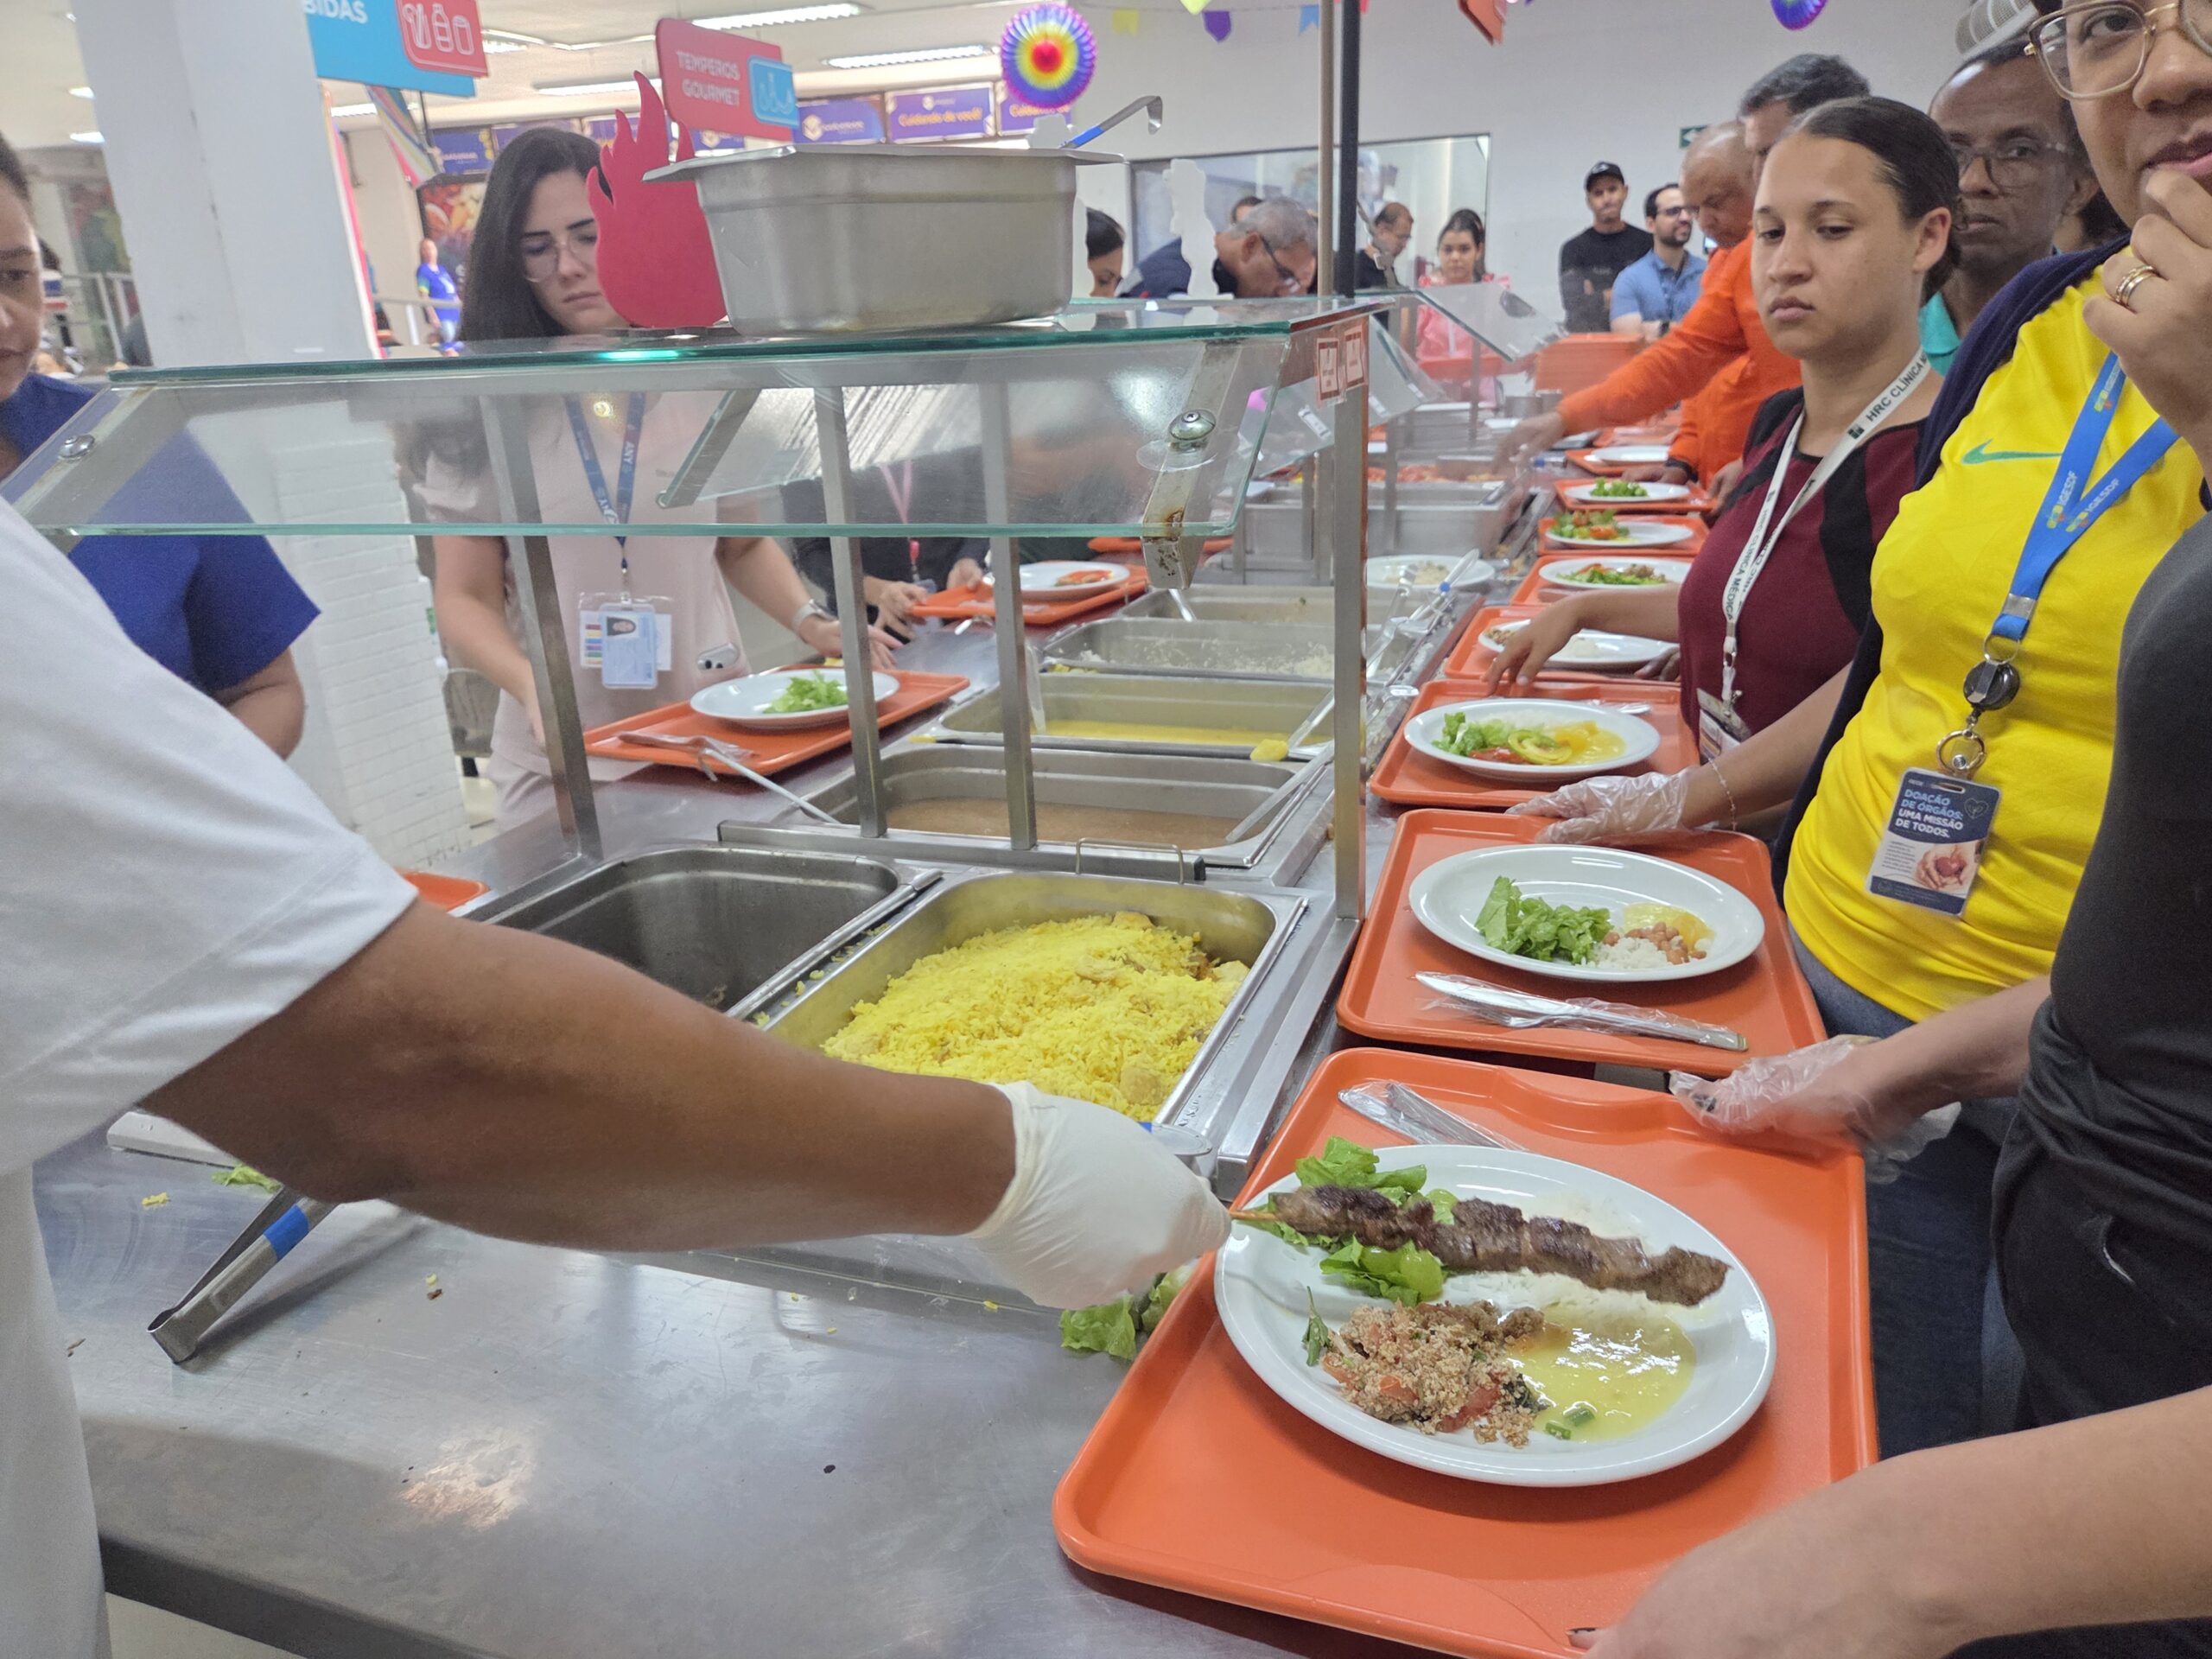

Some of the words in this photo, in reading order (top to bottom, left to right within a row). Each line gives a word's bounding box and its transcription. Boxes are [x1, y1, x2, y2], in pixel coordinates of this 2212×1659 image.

[676, 50, 741, 81] TEMPEROS
[682, 78, 741, 107] GOURMET
[1866, 397, 1891, 423] HRC
[1890, 361, 1923, 397] CLÍNICA
[2057, 469, 2077, 506] IGESDF
[2084, 477, 2120, 512] IGESDF
[1725, 577, 1743, 620] MÉDICA
[1901, 798, 1916, 809] DE
[1916, 802, 1964, 820] ÓRGÃOS:
[1904, 788, 1950, 806] DOAÇÃO
[1895, 817, 1910, 829] DE
[1912, 821, 1951, 838] TODOS.
[1897, 808, 1923, 821] UMA
[1923, 814, 1964, 830] MISSÃO
